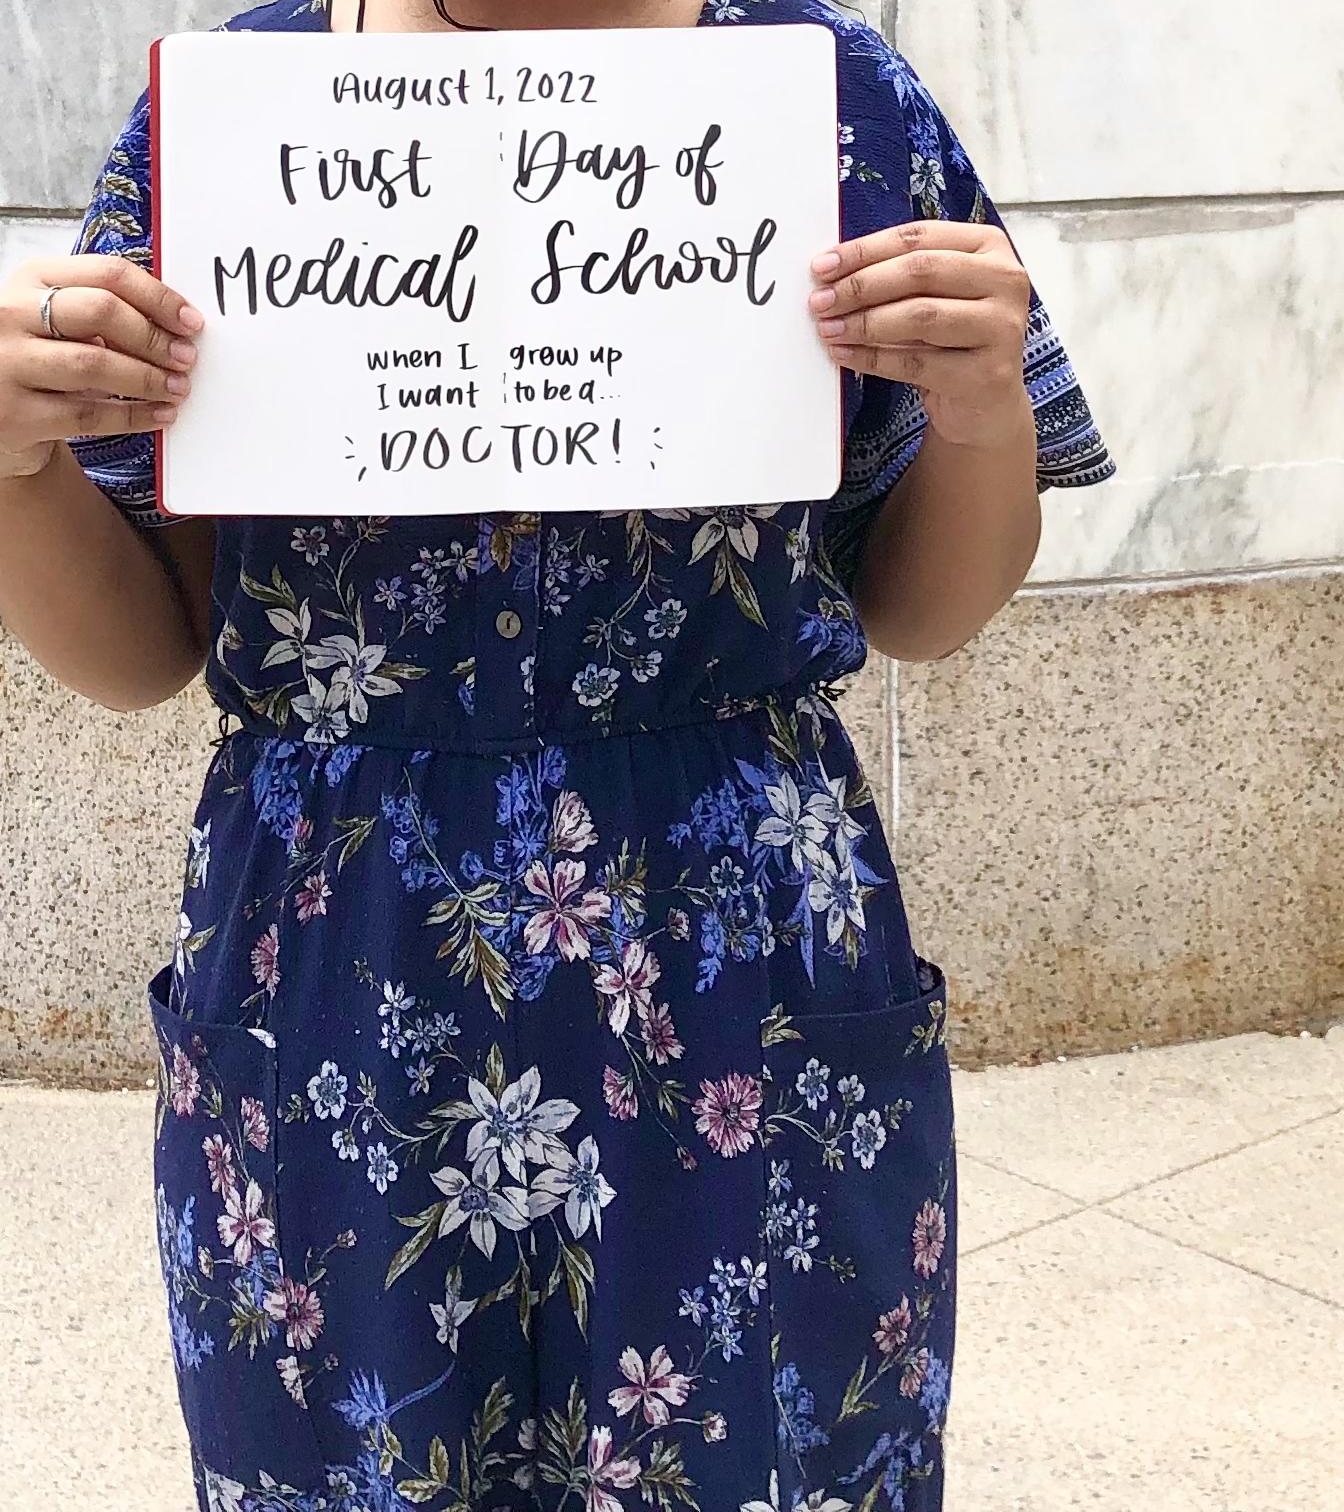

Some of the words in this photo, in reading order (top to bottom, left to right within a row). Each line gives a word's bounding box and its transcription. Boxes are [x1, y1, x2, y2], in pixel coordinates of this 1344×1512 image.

[333, 68, 470, 110] August
[485, 67, 504, 106] 1,
[517, 67, 598, 104] 2022
[280, 140, 433, 210] First
[513, 130, 661, 210] Day
[676, 124, 725, 207] of
[214, 225, 479, 323] Medical
[531, 218, 778, 307] School
[367, 350, 442, 371] when
[457, 343, 479, 370] I
[510, 345, 579, 371] grow
[590, 346, 623, 377] up
[377, 384, 391, 411] I
[399, 381, 480, 409] want
[513, 381, 536, 404] to
[544, 379, 573, 402] be
[381, 418, 621, 474] DOCTOR!
